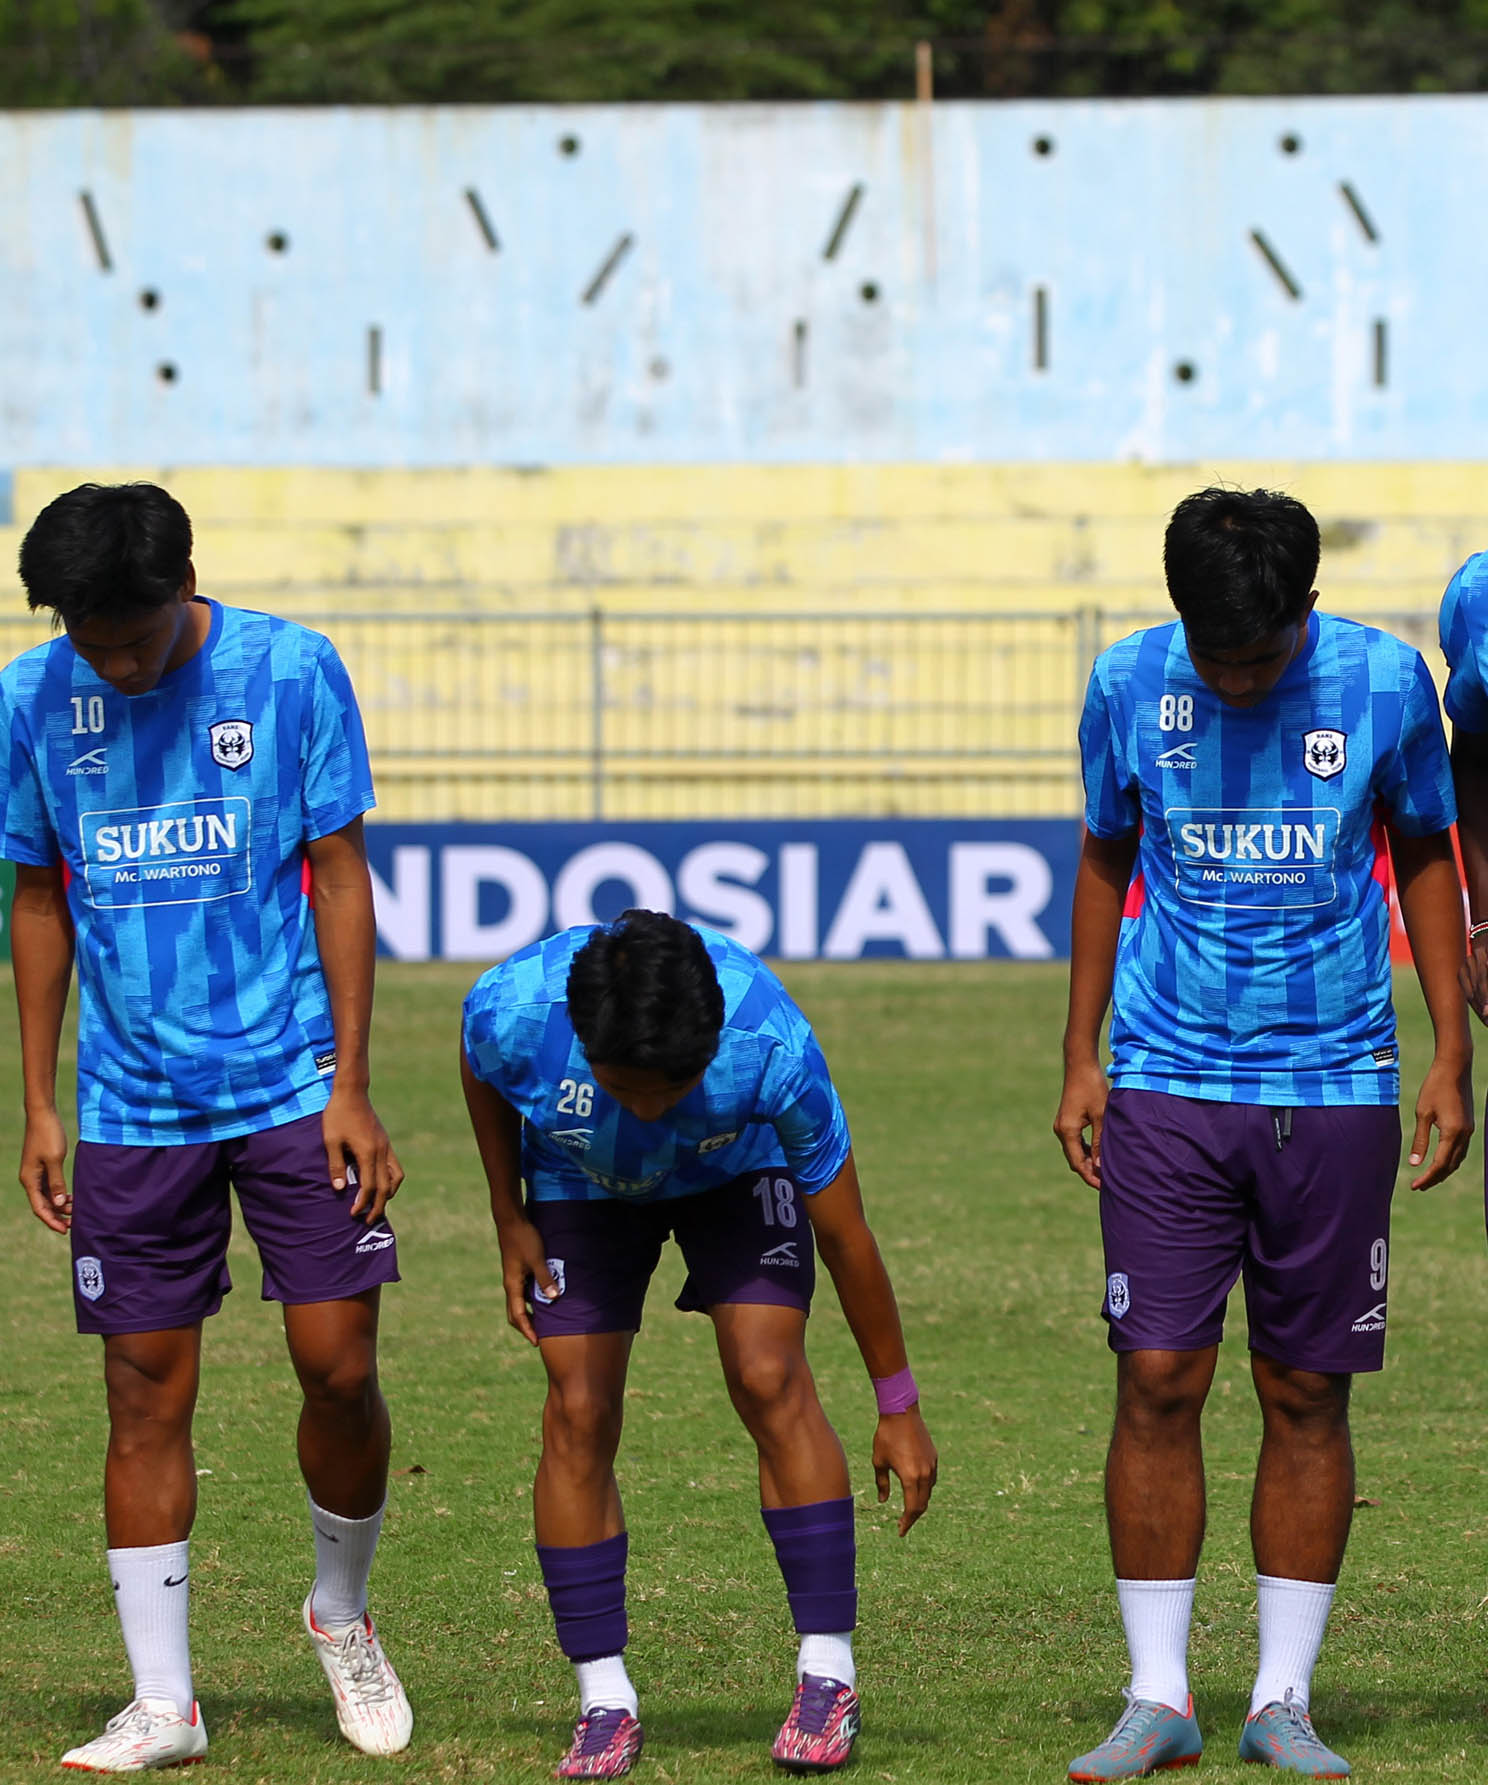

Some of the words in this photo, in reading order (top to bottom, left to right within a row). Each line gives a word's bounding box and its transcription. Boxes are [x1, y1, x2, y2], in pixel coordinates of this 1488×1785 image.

[70, 696, 105, 735] 10
[1159, 694, 1194, 732] 88
[65, 764, 109, 776] HUNDRED
[1155, 759, 1198, 769] HUNDRED
[96, 812, 237, 863] SUKUN
[1180, 823, 1326, 861] SUKUN
[115, 869, 142, 884] Mc.
[144, 862, 221, 881] WARTONO
[1202, 869, 1228, 883] Mc.
[1230, 871, 1306, 885] WARTONO
[368, 841, 1054, 962] NDOSIAR
[557, 1079, 594, 1117] 26
[753, 1177, 797, 1228] 18
[1370, 1238, 1387, 1291] 9
[1352, 1321, 1386, 1332] HUNDRED
